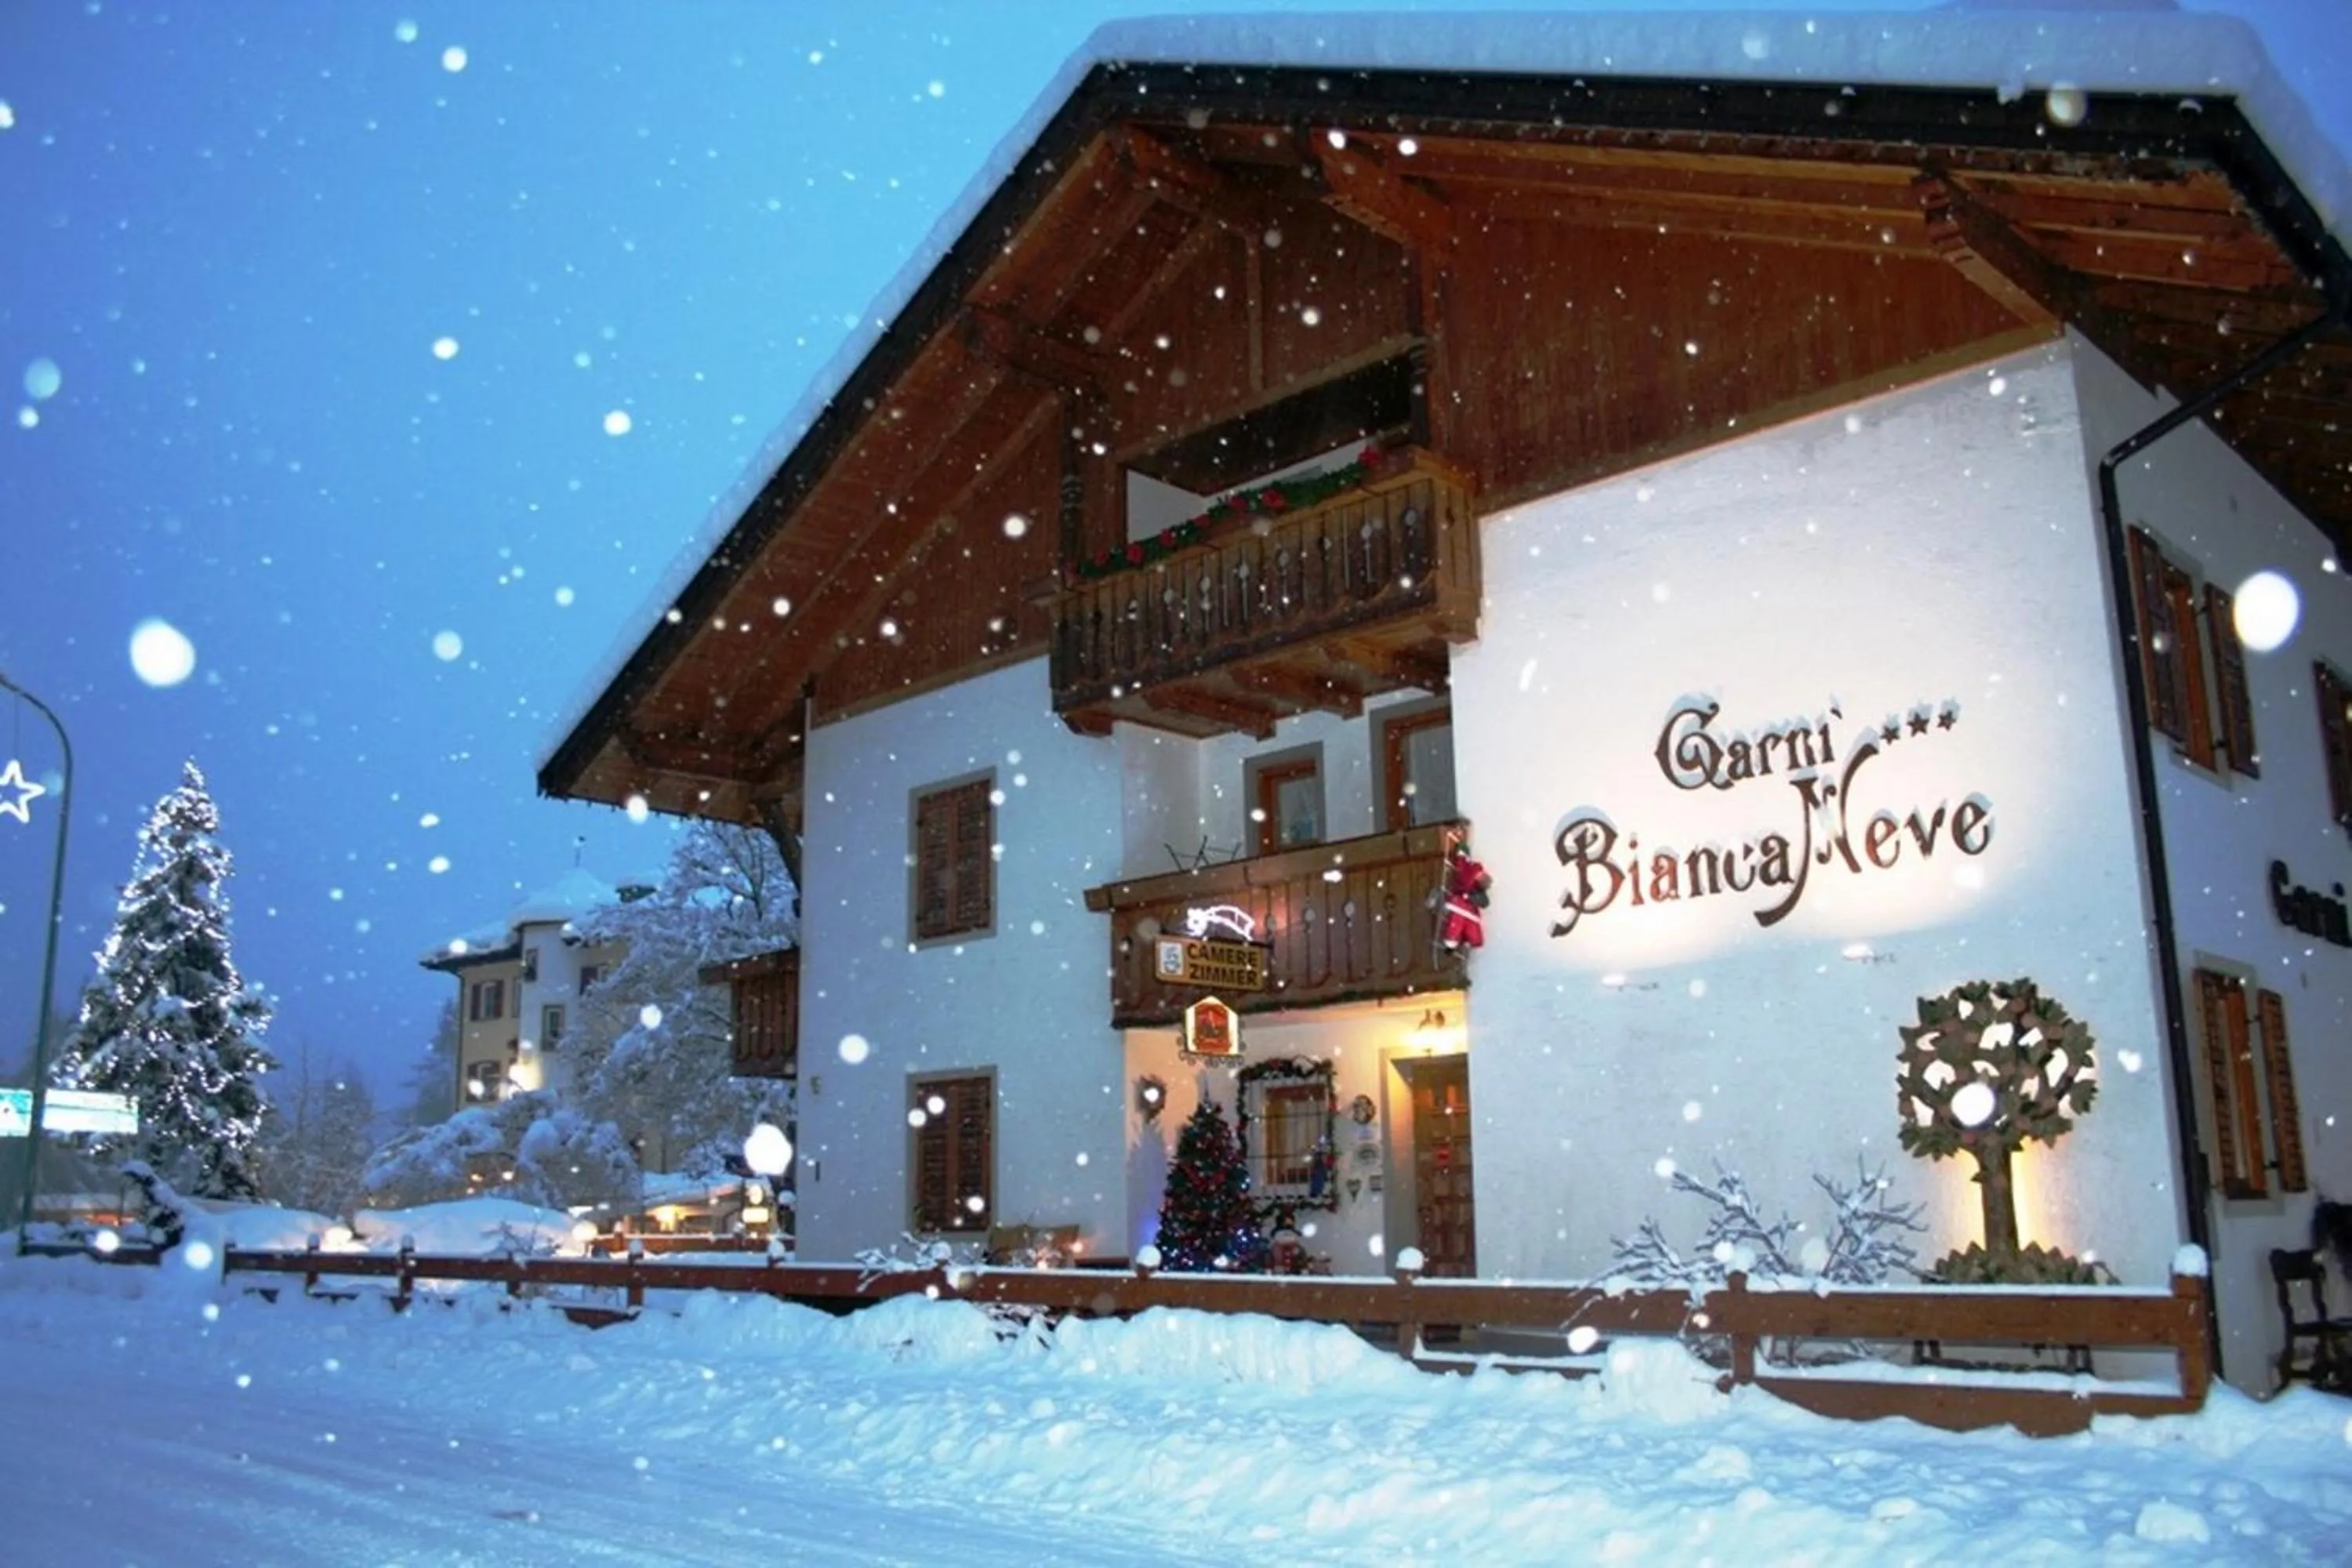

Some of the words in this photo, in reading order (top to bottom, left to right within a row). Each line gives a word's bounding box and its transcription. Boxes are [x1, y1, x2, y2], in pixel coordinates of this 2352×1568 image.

[1654, 702, 1842, 790] Garni
[1187, 942, 1258, 967] CAMERE
[1189, 964, 1258, 986] ZIMMER
